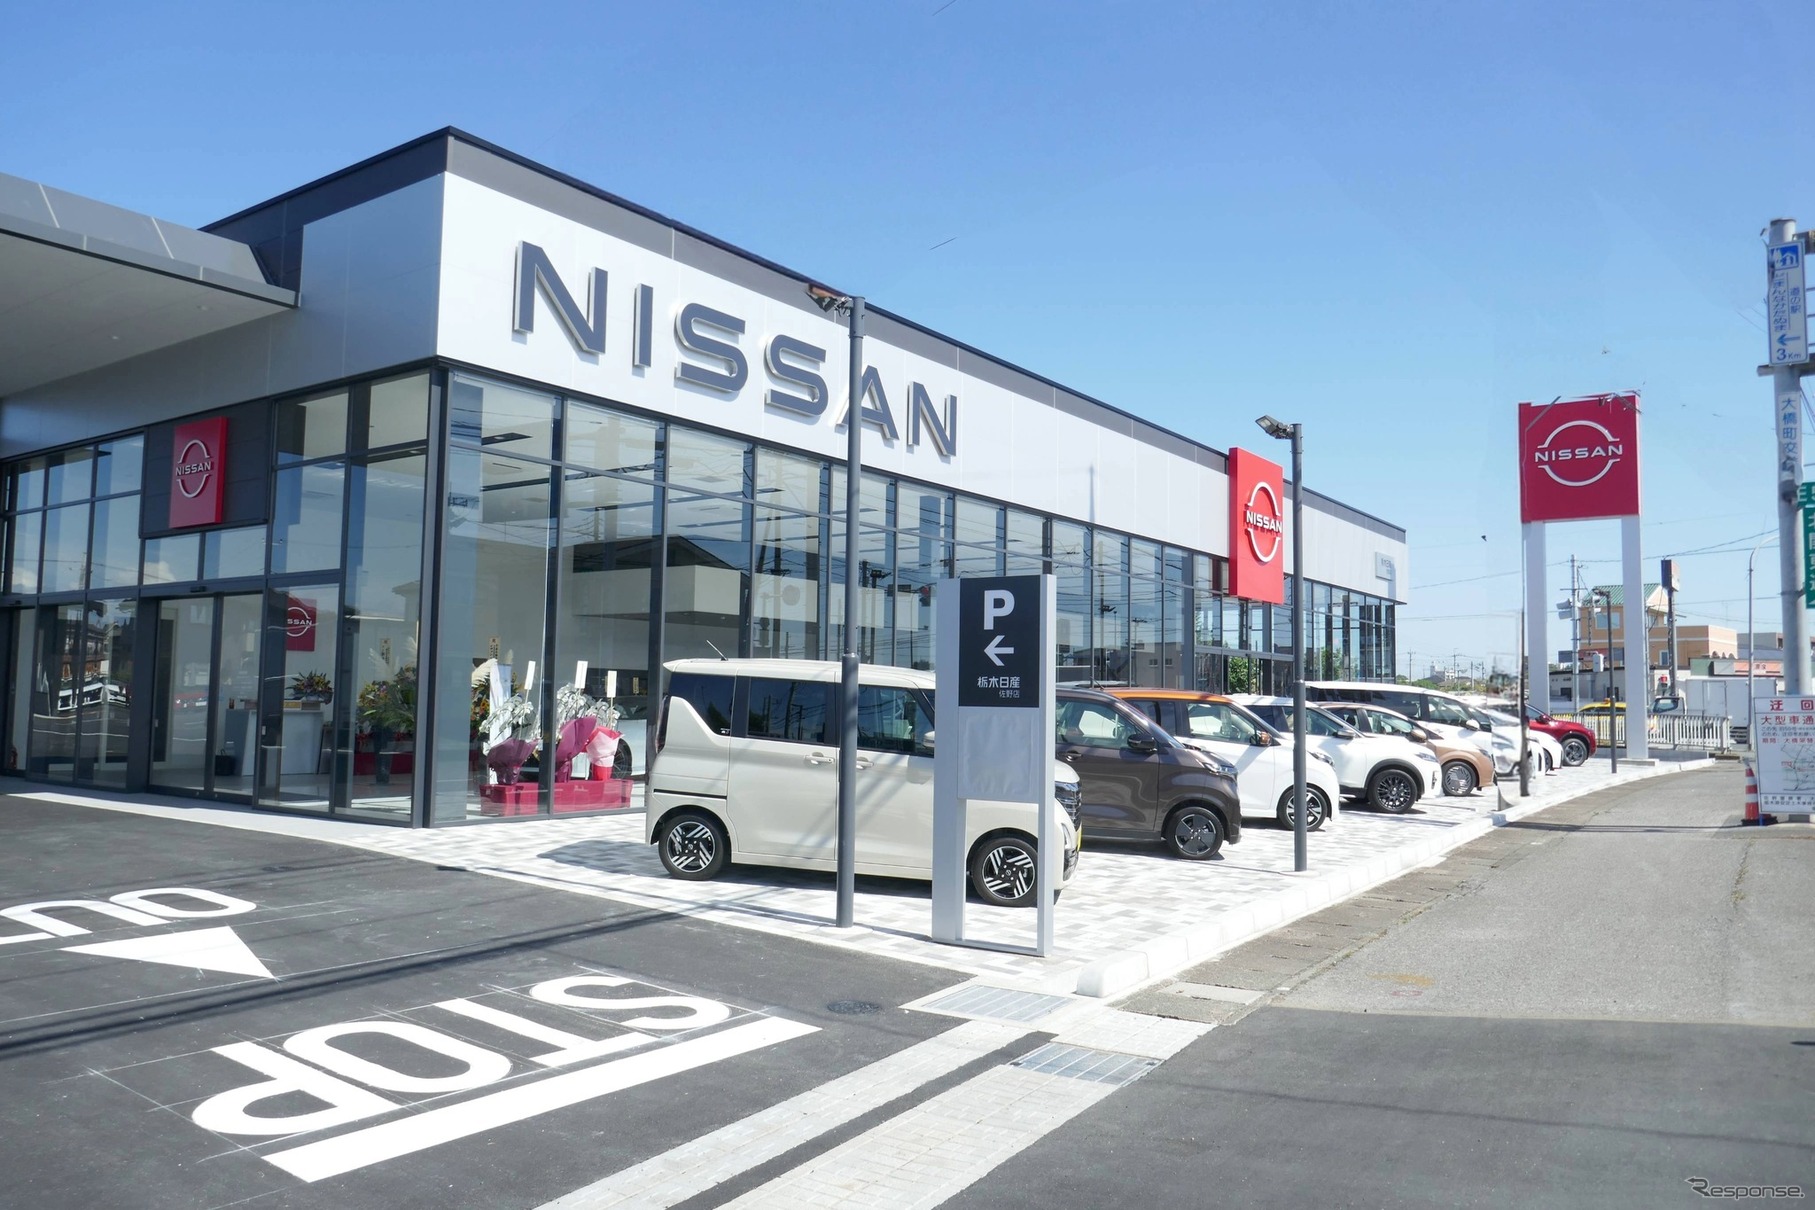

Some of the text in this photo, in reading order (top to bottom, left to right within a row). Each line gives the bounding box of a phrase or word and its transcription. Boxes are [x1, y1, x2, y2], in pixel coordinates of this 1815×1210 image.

[512, 240, 957, 456] NISSAN
[1534, 444, 1623, 462] NISSAN
[175, 461, 212, 476] NISSAN
[1246, 510, 1283, 534] NISSAN
[983, 589, 1015, 630] P
[287, 618, 312, 626] SSAN
[977, 676, 1020, 688] 栃木日産
[0, 887, 257, 945] OU
[191, 974, 732, 1136] STOP
